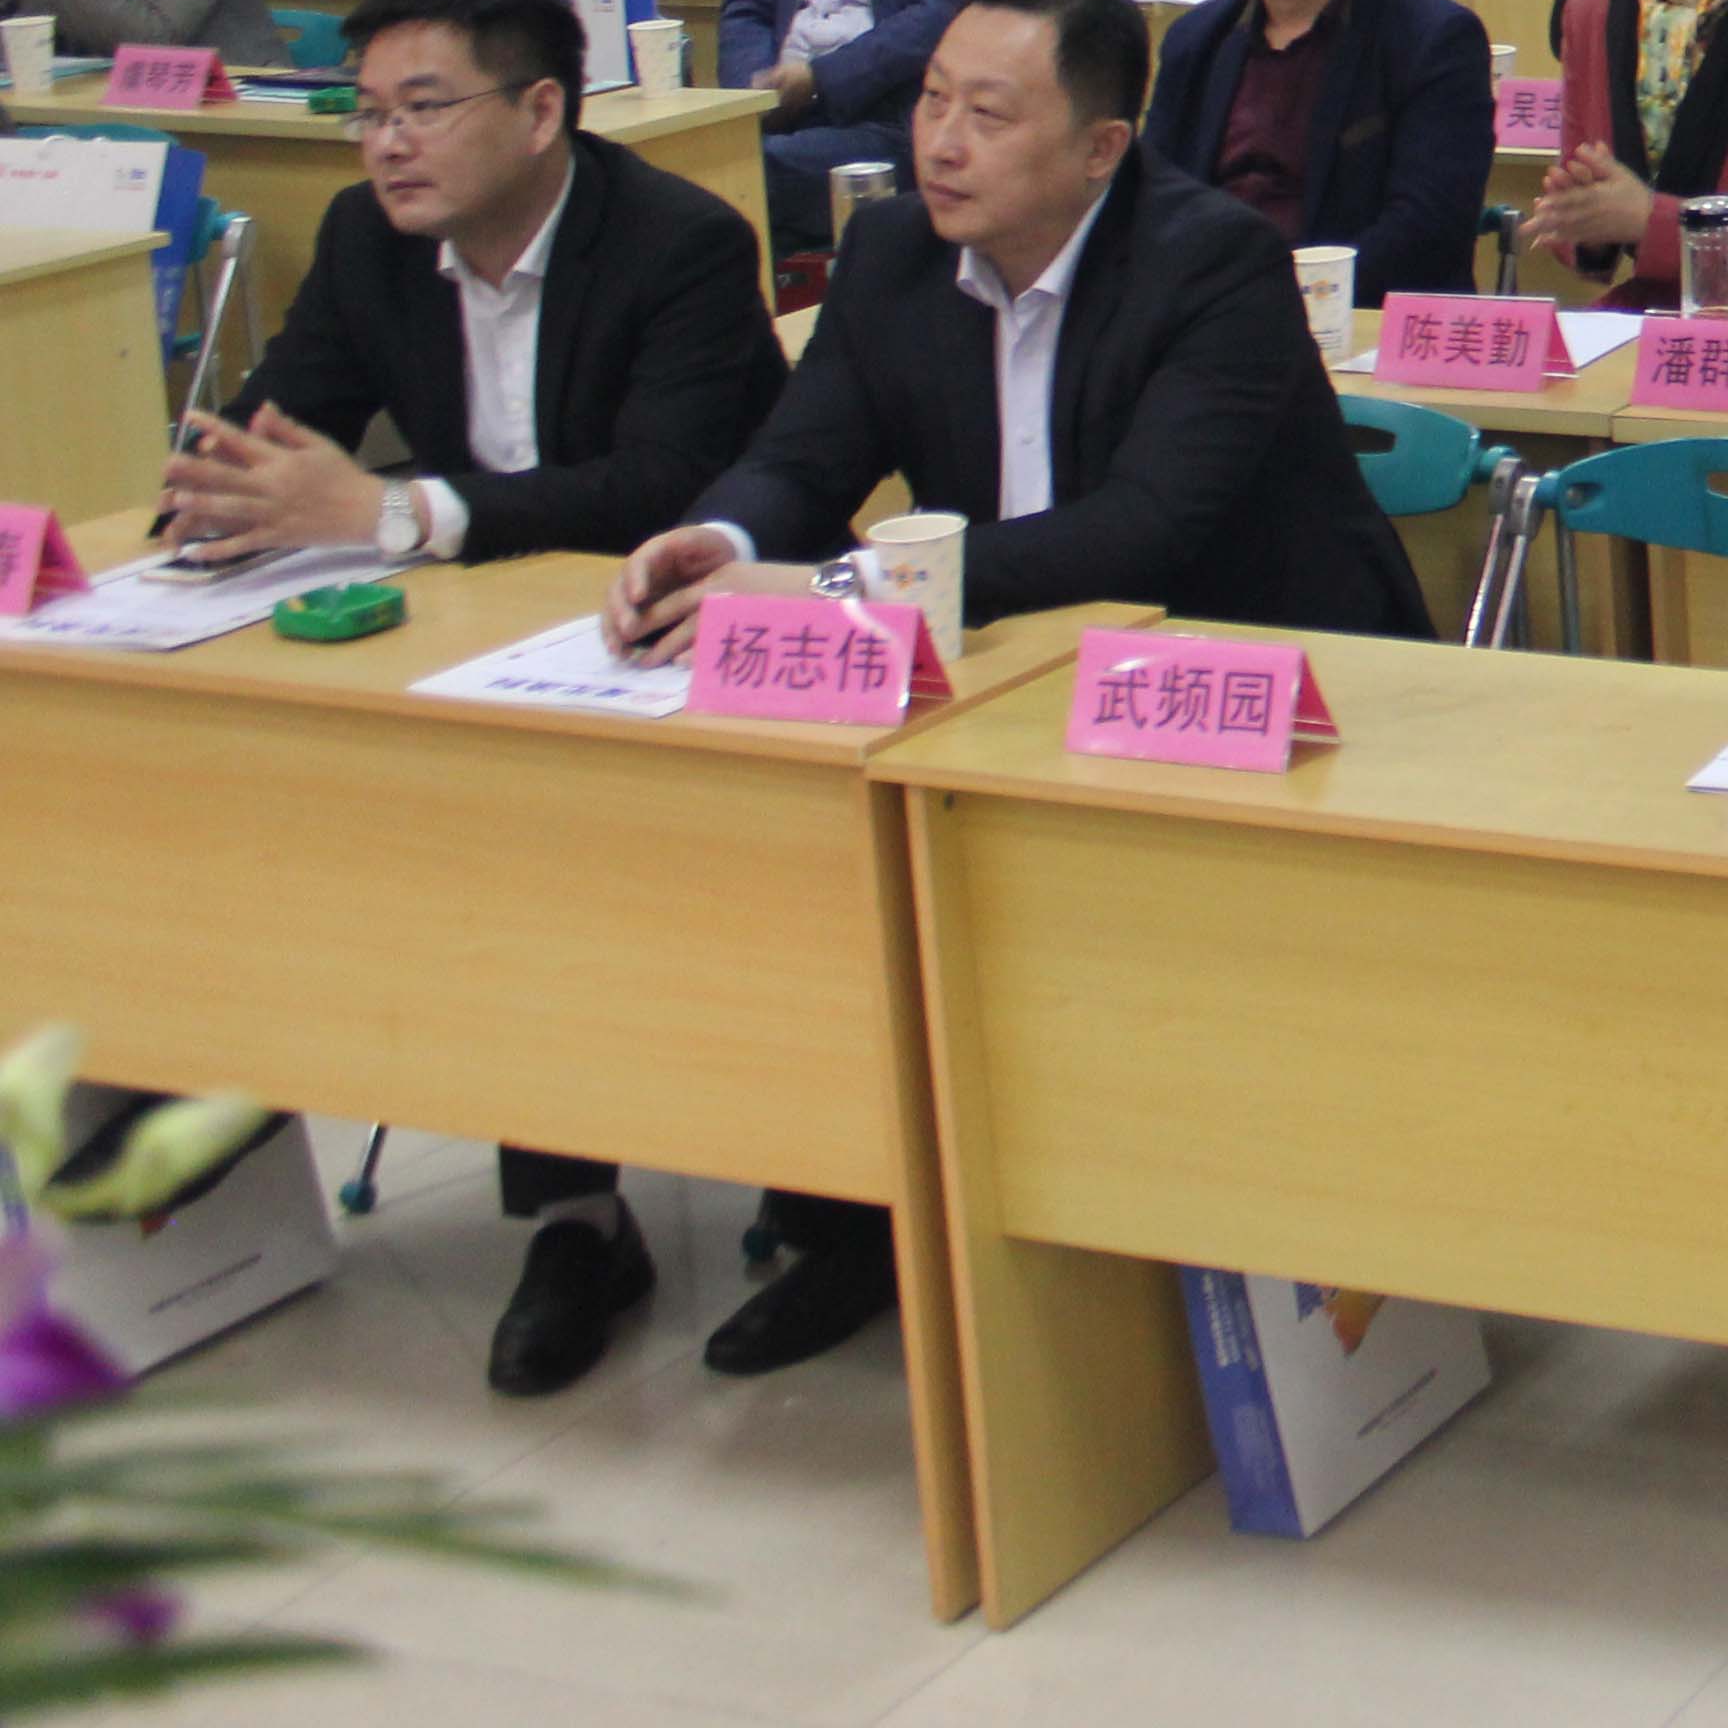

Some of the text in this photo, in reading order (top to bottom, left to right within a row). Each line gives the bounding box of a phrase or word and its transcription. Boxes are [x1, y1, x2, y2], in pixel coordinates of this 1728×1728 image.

[1400, 314, 1530, 367] 陈美勤
[715, 624, 889, 692] 杨志伟
[1093, 665, 1274, 736] 武频园
